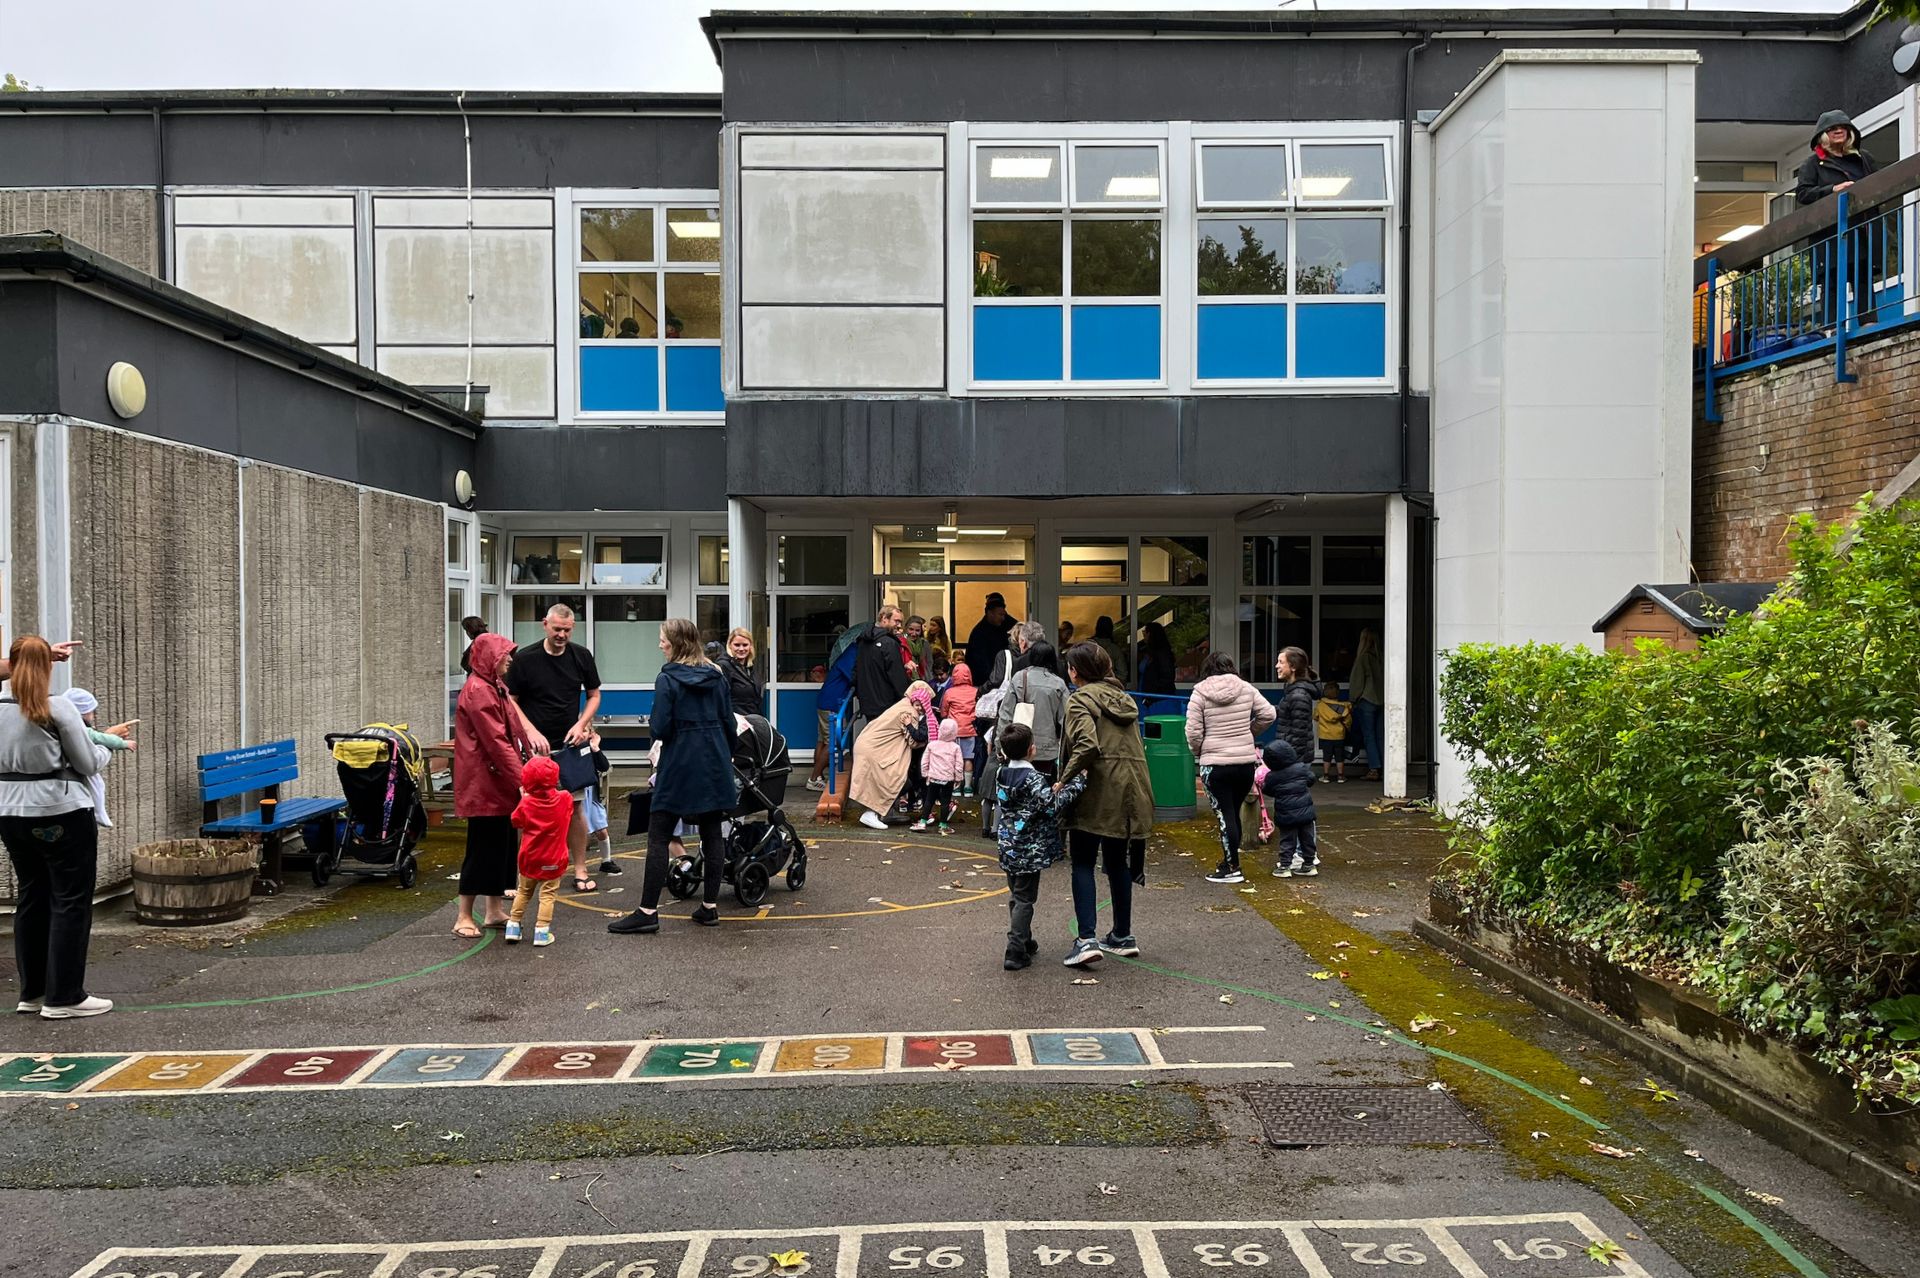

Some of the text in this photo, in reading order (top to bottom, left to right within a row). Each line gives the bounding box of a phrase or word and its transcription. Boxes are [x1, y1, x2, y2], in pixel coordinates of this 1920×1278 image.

[678, 1049, 721, 1069] 70
[813, 1045, 851, 1062] 80
[939, 1041, 976, 1059] 90
[1063, 1037, 1106, 1061] 100
[148, 1061, 202, 1080] 30
[283, 1056, 334, 1076] 40
[417, 1055, 465, 1073] 50
[553, 1052, 596, 1070] 60
[19, 1062, 76, 1083] 20
[889, 1246, 964, 1270] 95
[1033, 1244, 1116, 1266] 94
[1193, 1243, 1269, 1267] 93
[1342, 1242, 1427, 1265] 92
[1492, 1237, 1567, 1260] 91
[729, 1254, 812, 1277] 96
